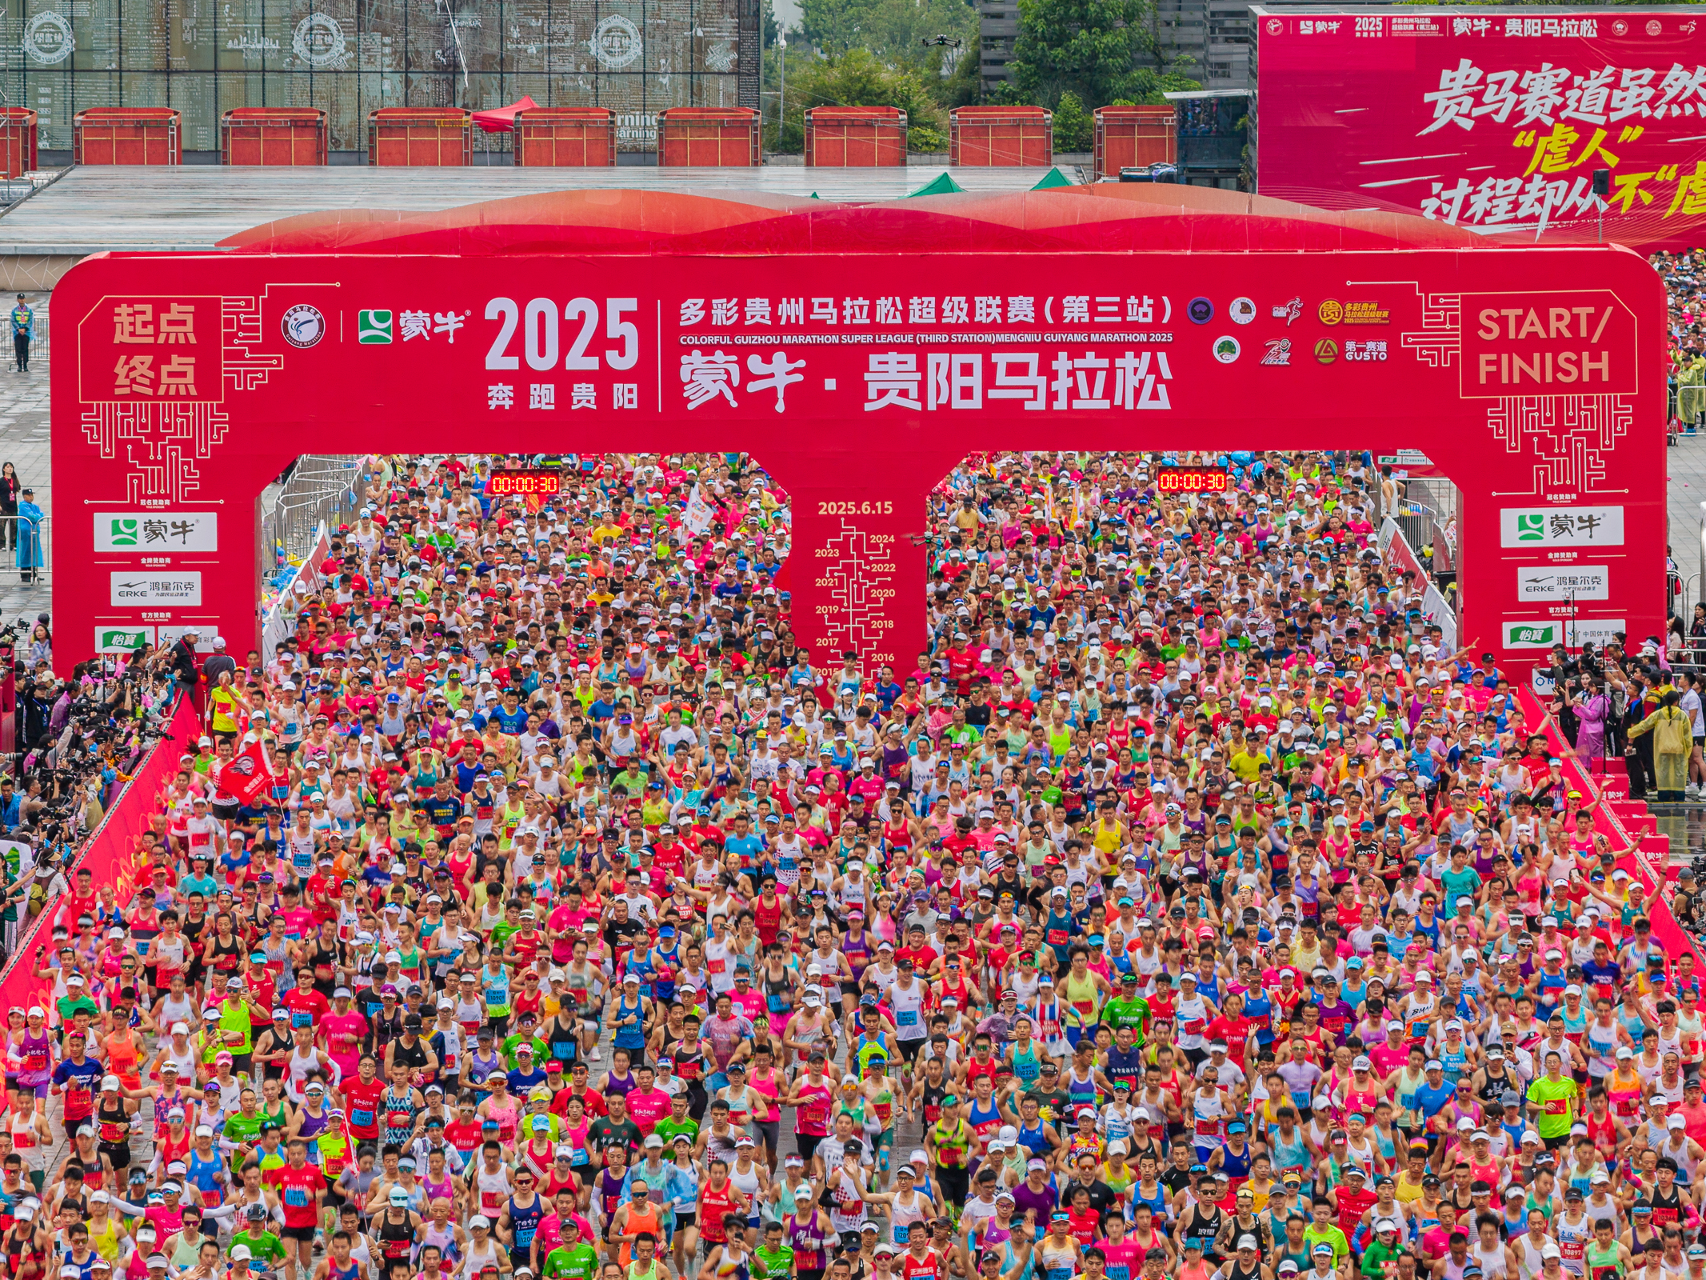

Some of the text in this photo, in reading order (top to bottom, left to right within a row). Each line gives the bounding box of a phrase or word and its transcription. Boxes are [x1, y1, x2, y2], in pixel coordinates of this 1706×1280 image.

[1315, 20, 1340, 34] 蒙牛
[1355, 17, 1382, 31] 2025
[113, 303, 197, 344] 起点
[400, 309, 466, 343] 蒙牛
[1477, 306, 1614, 344] START/
[484, 297, 639, 370] 2025
[680, 334, 732, 344] COLORFUL
[734, 334, 780, 344] GUIZHOU
[782, 334, 839, 344] MARATHON
[841, 334, 873, 344] SUPER
[875, 334, 913, 344] LEAGUE
[916, 333, 949, 344] (THIRD
[1044, 333, 1088, 344] GUIYANG
[1090, 333, 1147, 344] MARATHON
[1150, 333, 1173, 344] 2025
[1345, 341, 1387, 352] 第一赛道
[1345, 352, 1387, 361] GUSTO
[1479, 351, 1609, 384] FINISH
[113, 354, 197, 396] 终点
[488, 383, 638, 410] 奔跑贵阳
[493, 477, 557, 492] 00:00:30
[1160, 473, 1225, 489] 00:00:30
[818, 501, 893, 515] 2025.6.15
[143, 519, 195, 545] 蒙牛
[1550, 514, 1602, 539] 蒙牛
[870, 535, 895, 543] 2024
[815, 549, 840, 557] 2023
[871, 564, 896, 572] 2022
[149, 581, 195, 591] 鸿星尔克
[815, 578, 839, 586] 2021
[1556, 576, 1602, 586] 鸿星尔克
[870, 589, 895, 597] 2020
[815, 606, 839, 614] 2019
[871, 620, 894, 629] 2018
[112, 634, 137, 645] 怡寶
[1519, 629, 1545, 641] 怡寶
[816, 638, 839, 646] 2017
[871, 654, 895, 662] 2016
[816, 668, 839, 676] 2015
[1607, 791, 1626, 800] 蒙牛
